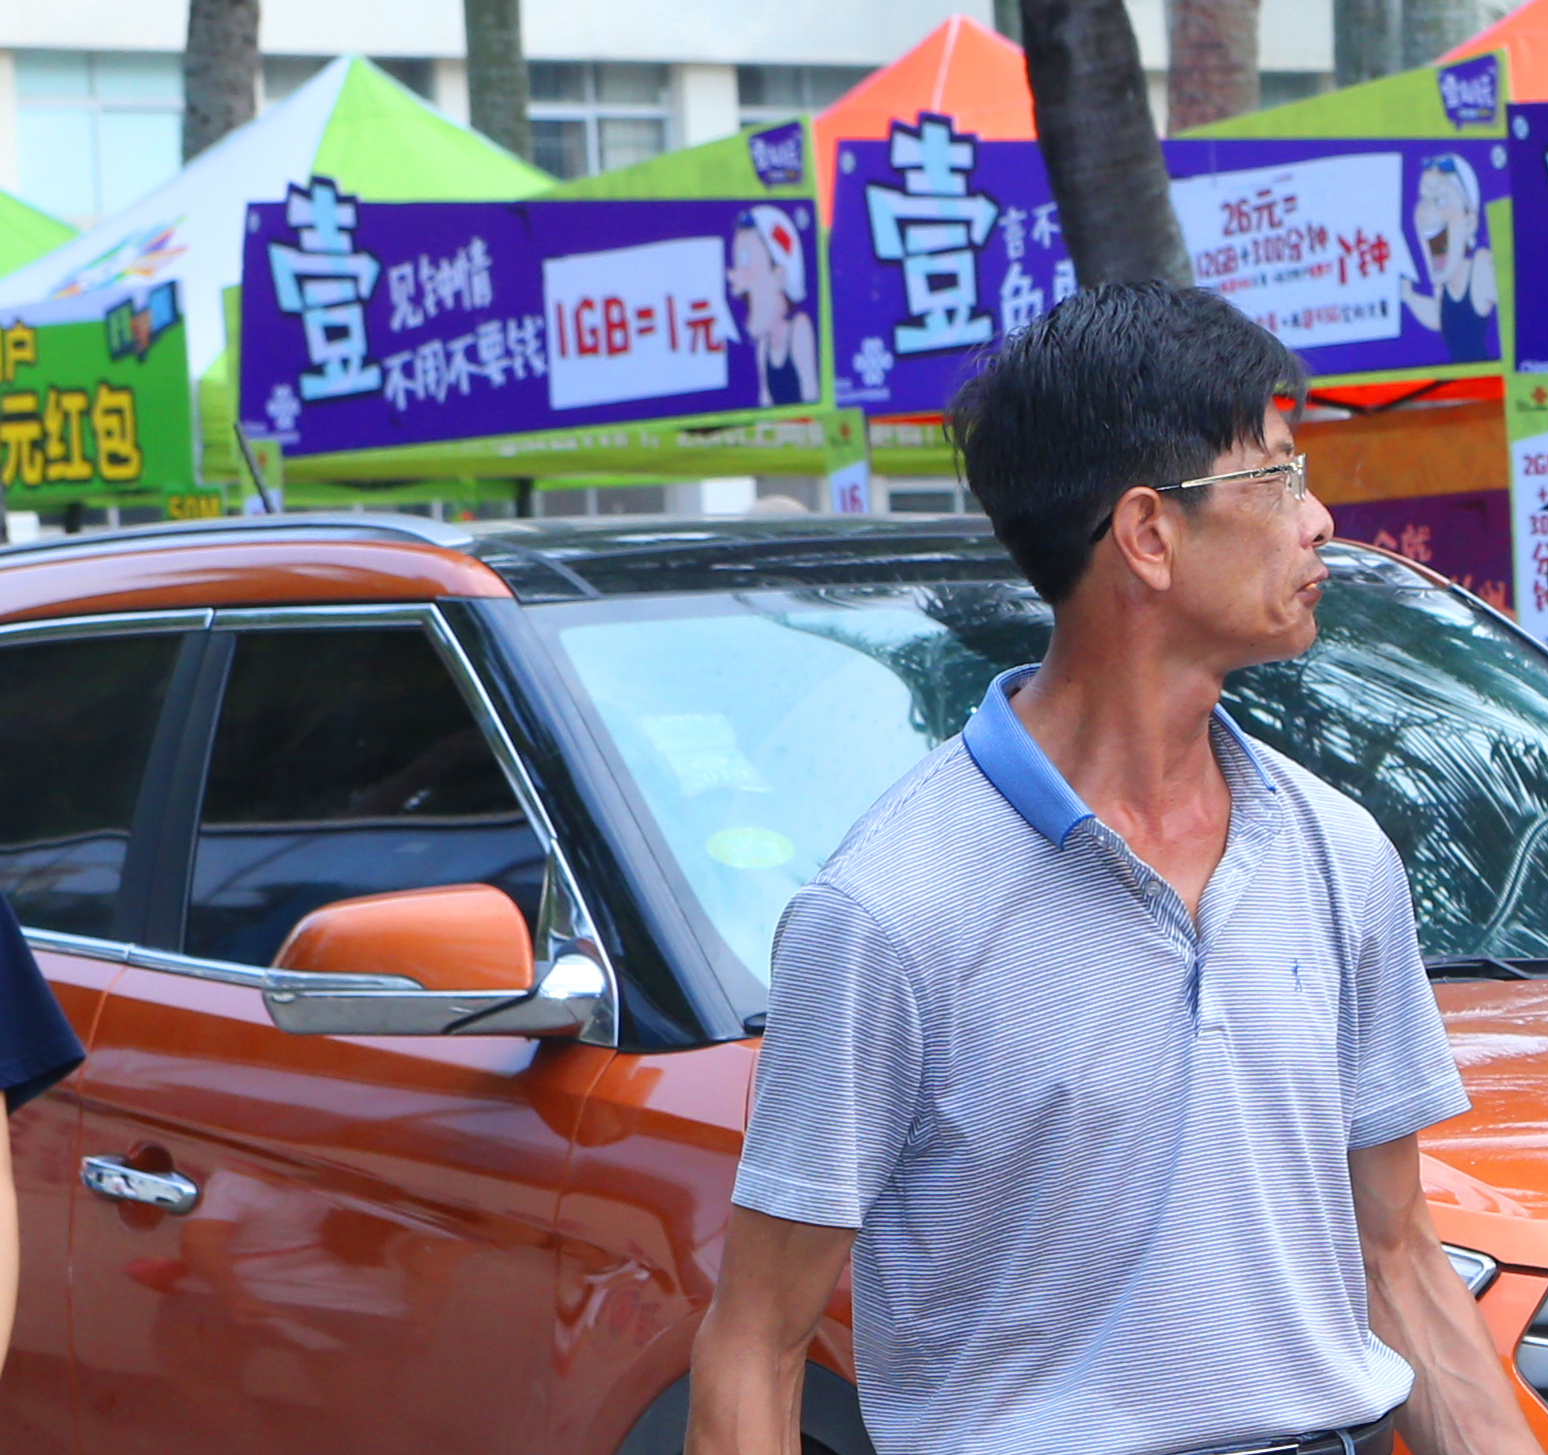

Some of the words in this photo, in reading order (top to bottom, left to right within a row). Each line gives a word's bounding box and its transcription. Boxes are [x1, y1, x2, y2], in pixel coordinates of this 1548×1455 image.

[387, 236, 492, 332] 见钟情
[866, 121, 999, 354] 壹
[267, 182, 380, 400] 壹
[556, 298, 727, 358] 1GB=1元
[382, 314, 548, 412] 不用不要钱
